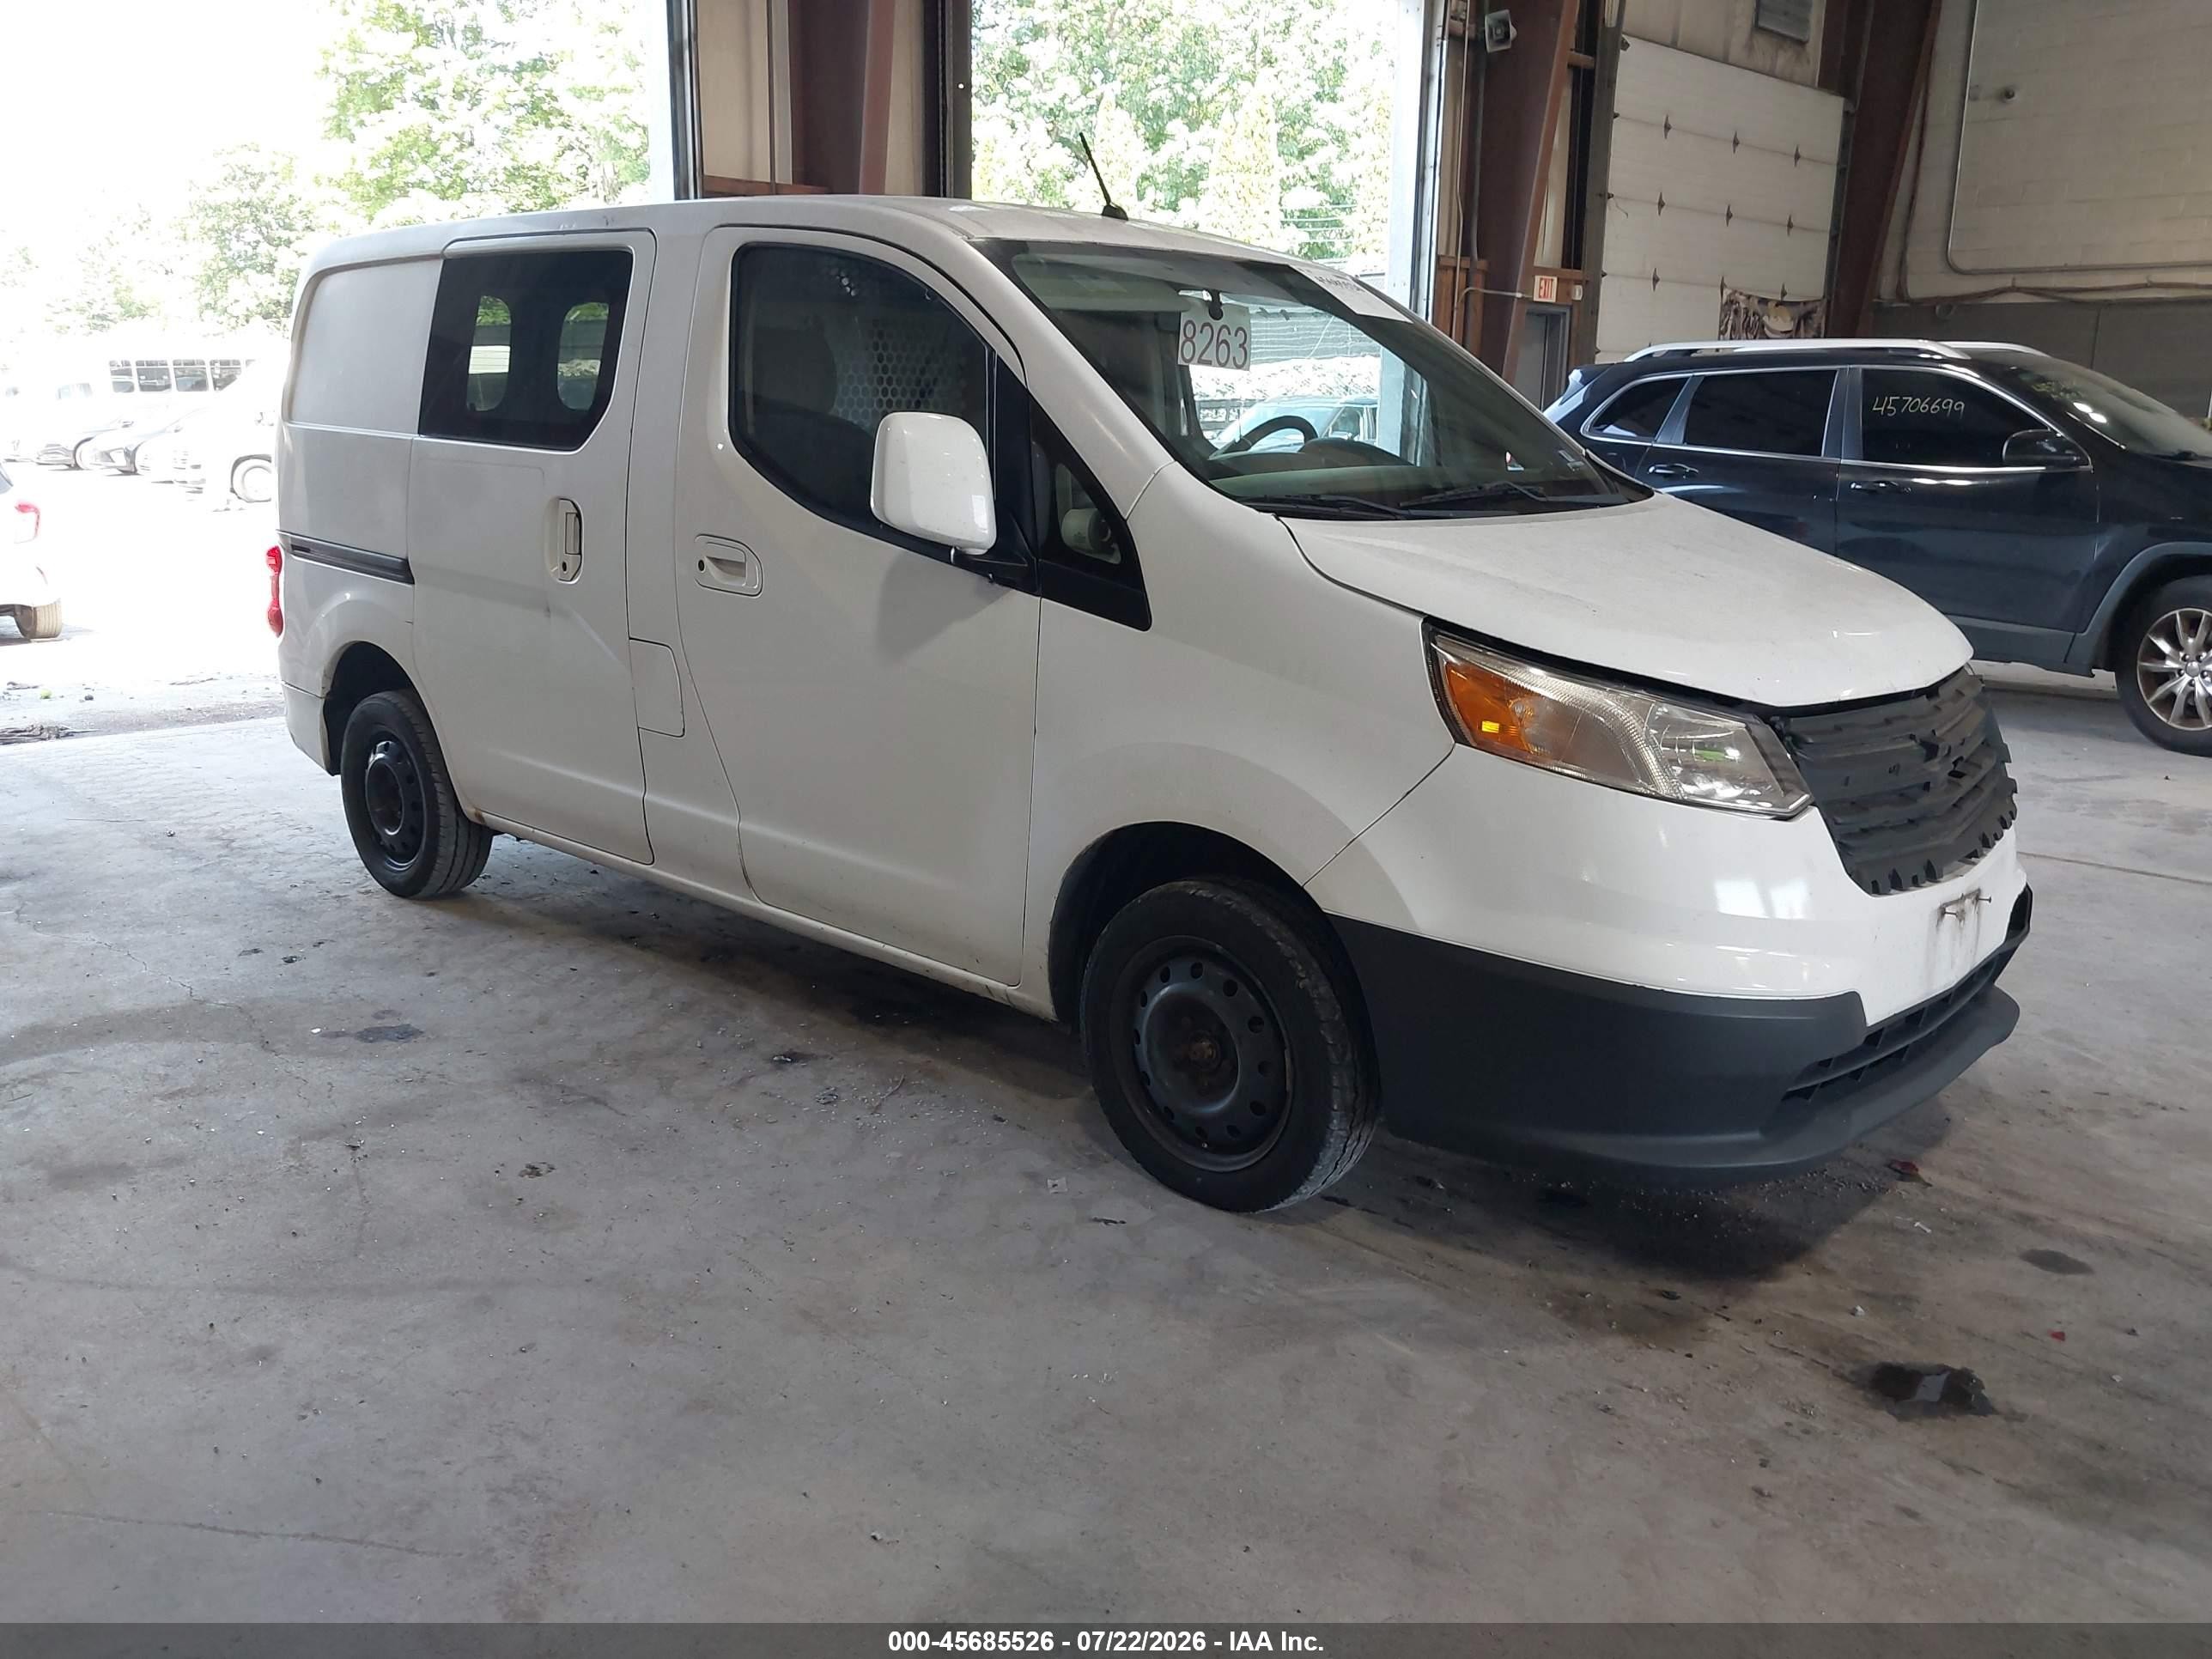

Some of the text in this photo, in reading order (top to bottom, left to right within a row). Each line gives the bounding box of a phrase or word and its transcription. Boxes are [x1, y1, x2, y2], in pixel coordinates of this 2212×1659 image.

[1539, 277, 1554, 299] EXIT
[1180, 319, 1248, 369] 8263
[1872, 395, 1966, 419] 45706699
